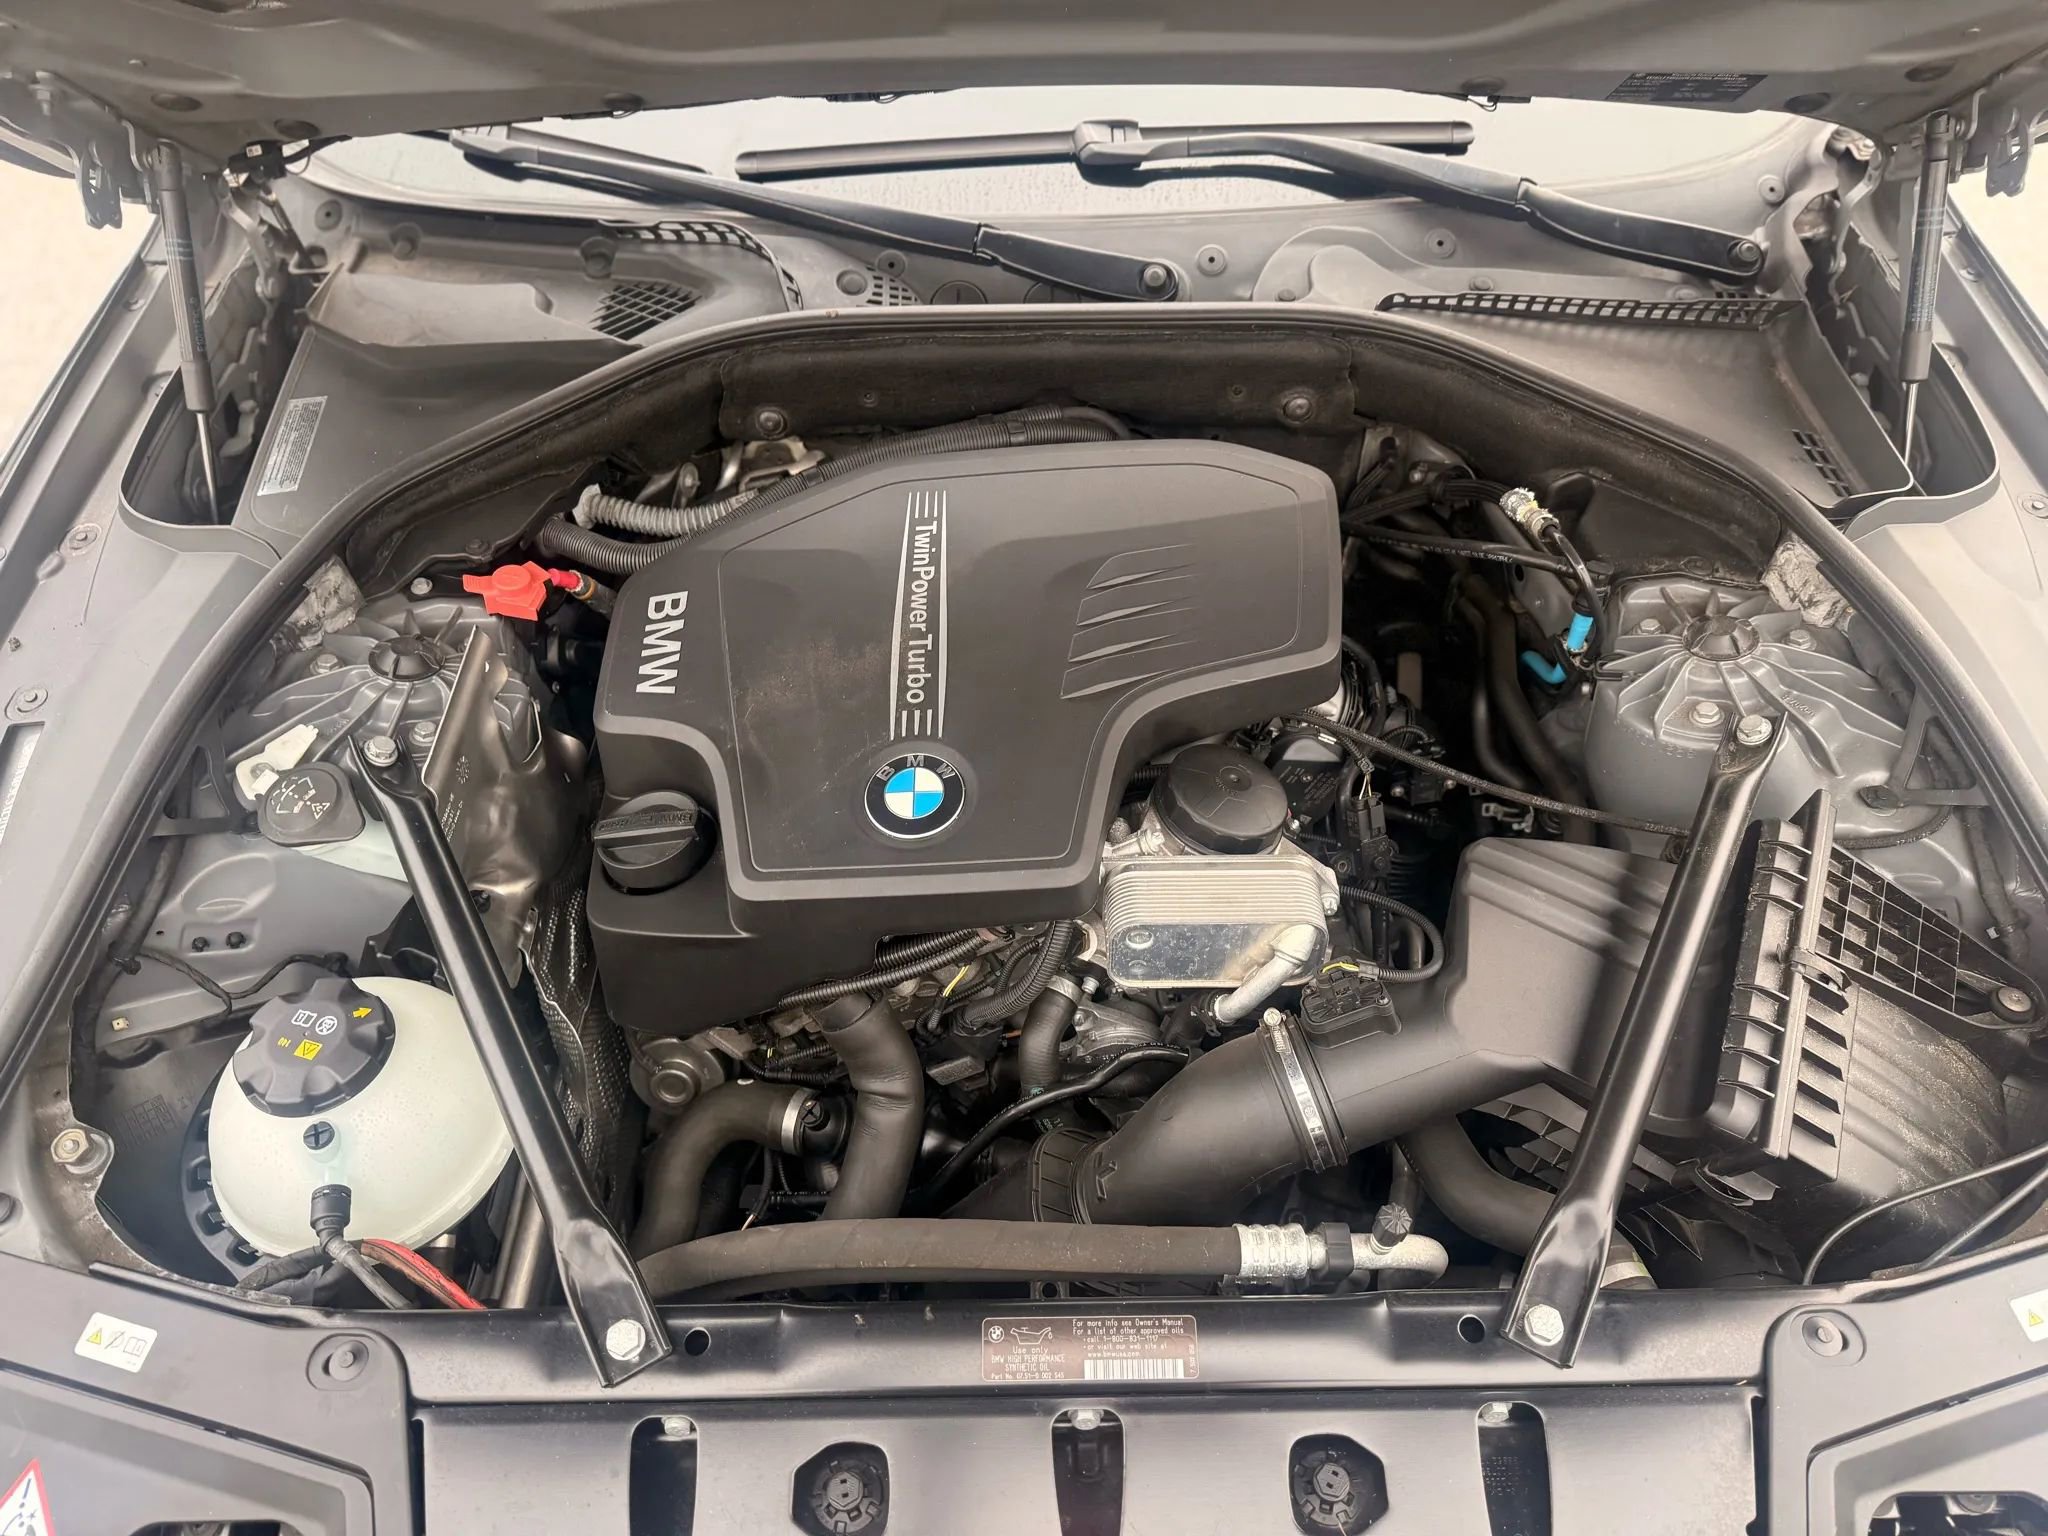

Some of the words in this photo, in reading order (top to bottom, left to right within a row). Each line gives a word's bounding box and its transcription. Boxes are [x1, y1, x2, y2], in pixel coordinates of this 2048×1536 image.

[909, 520, 938, 632] TwinPower
[635, 590, 689, 695] BMW
[906, 633, 933, 704] Turbo
[876, 755, 956, 781] BMW
[1072, 1318, 1084, 1327] For
[1105, 1318, 1118, 1328] info
[1135, 1317, 1159, 1326] Owner's
[1161, 1317, 1184, 1326] Manual
[1072, 1327, 1084, 1335] For
[1094, 1327, 1106, 1335] list
[1109, 1327, 1117, 1335] of
[1120, 1326, 1137, 1335] other
[1140, 1326, 1168, 1335] approved
[1171, 1326, 1184, 1334] oils
[1012, 1346, 1027, 1354] Use
[1031, 1345, 1049, 1355] only
[991, 1354, 1005, 1364] BMW
[1007, 1354, 1022, 1363] HIGH
[1024, 1353, 1065, 1363] PERFORMANCE
[1005, 1363, 1037, 1372] SYNTHETIC
[1039, 1363, 1050, 1372] OIL
